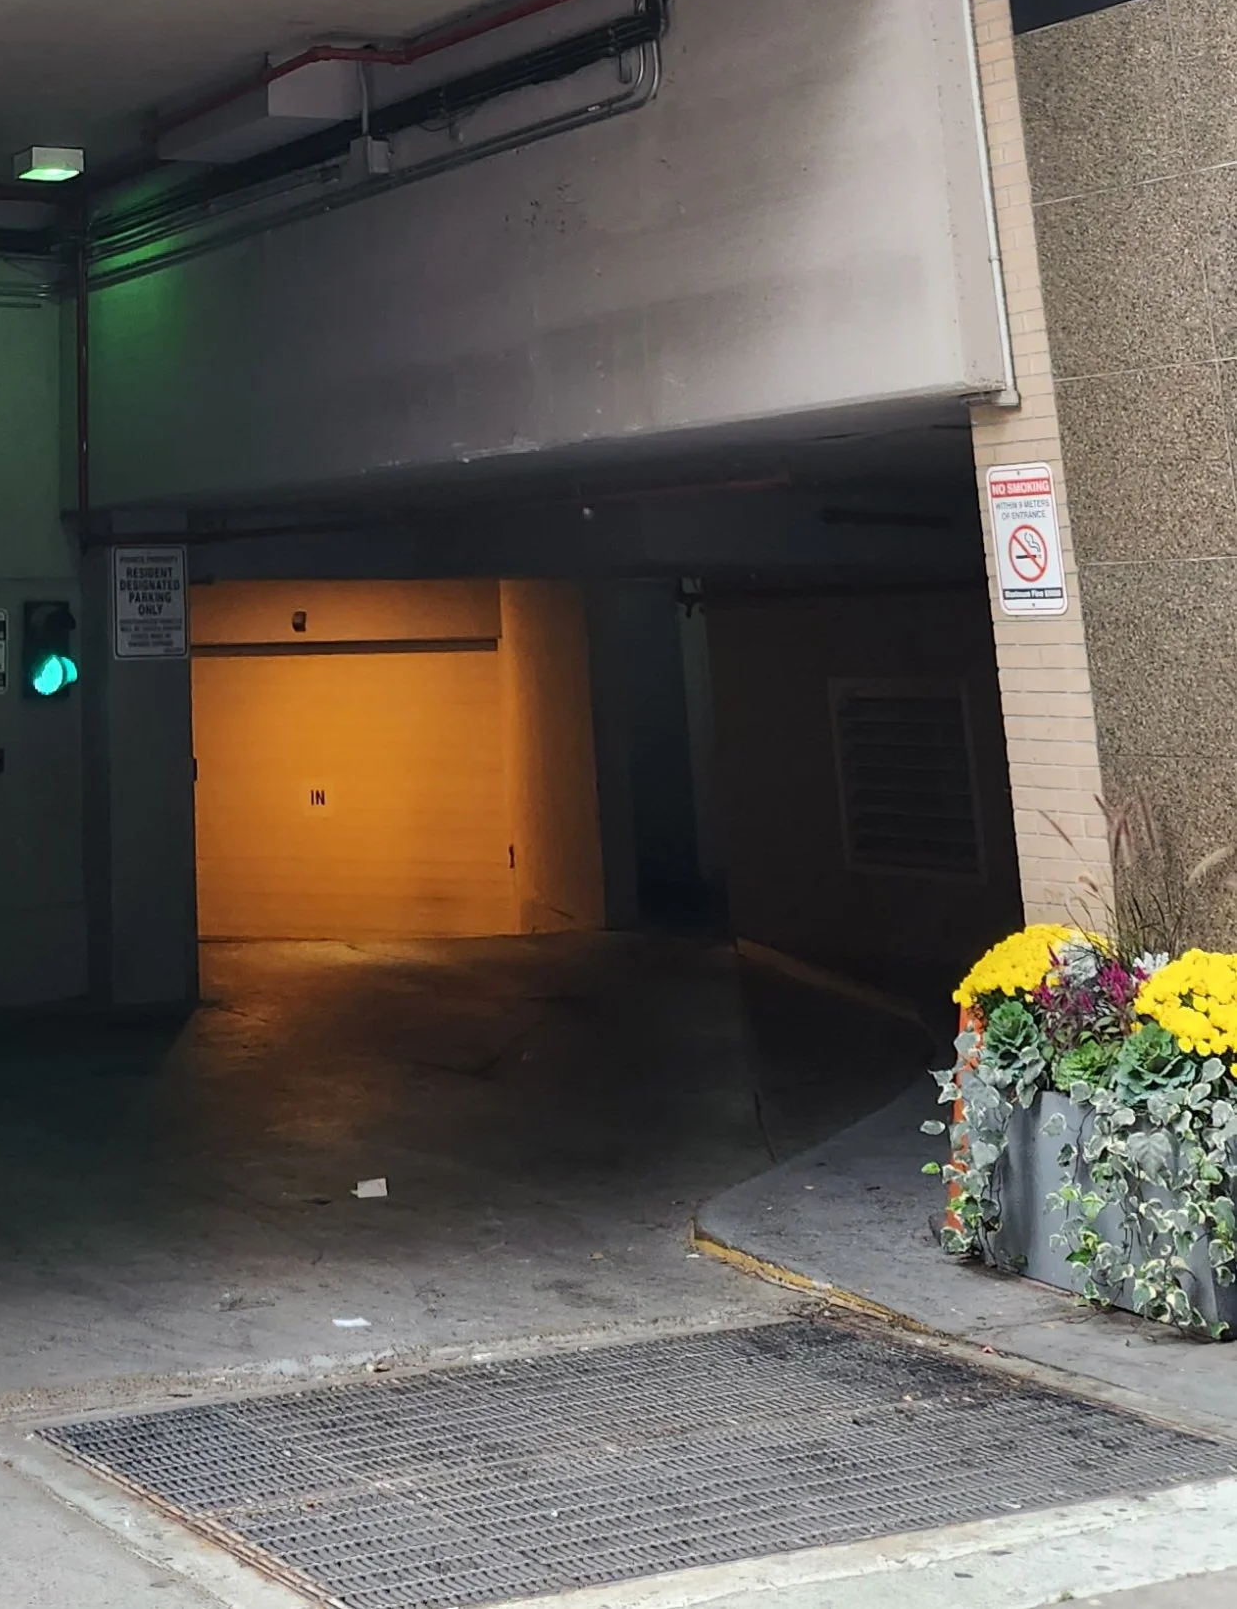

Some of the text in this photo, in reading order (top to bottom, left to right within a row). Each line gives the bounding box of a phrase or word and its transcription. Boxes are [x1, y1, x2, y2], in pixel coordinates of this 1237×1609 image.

[991, 480, 1050, 496] NO SMOKING
[126, 566, 172, 579] RESIDENT
[119, 579, 180, 591] DESIGNATED
[129, 591, 172, 603] PARKING
[138, 603, 163, 616] ONLY
[310, 789, 325, 806] IN
